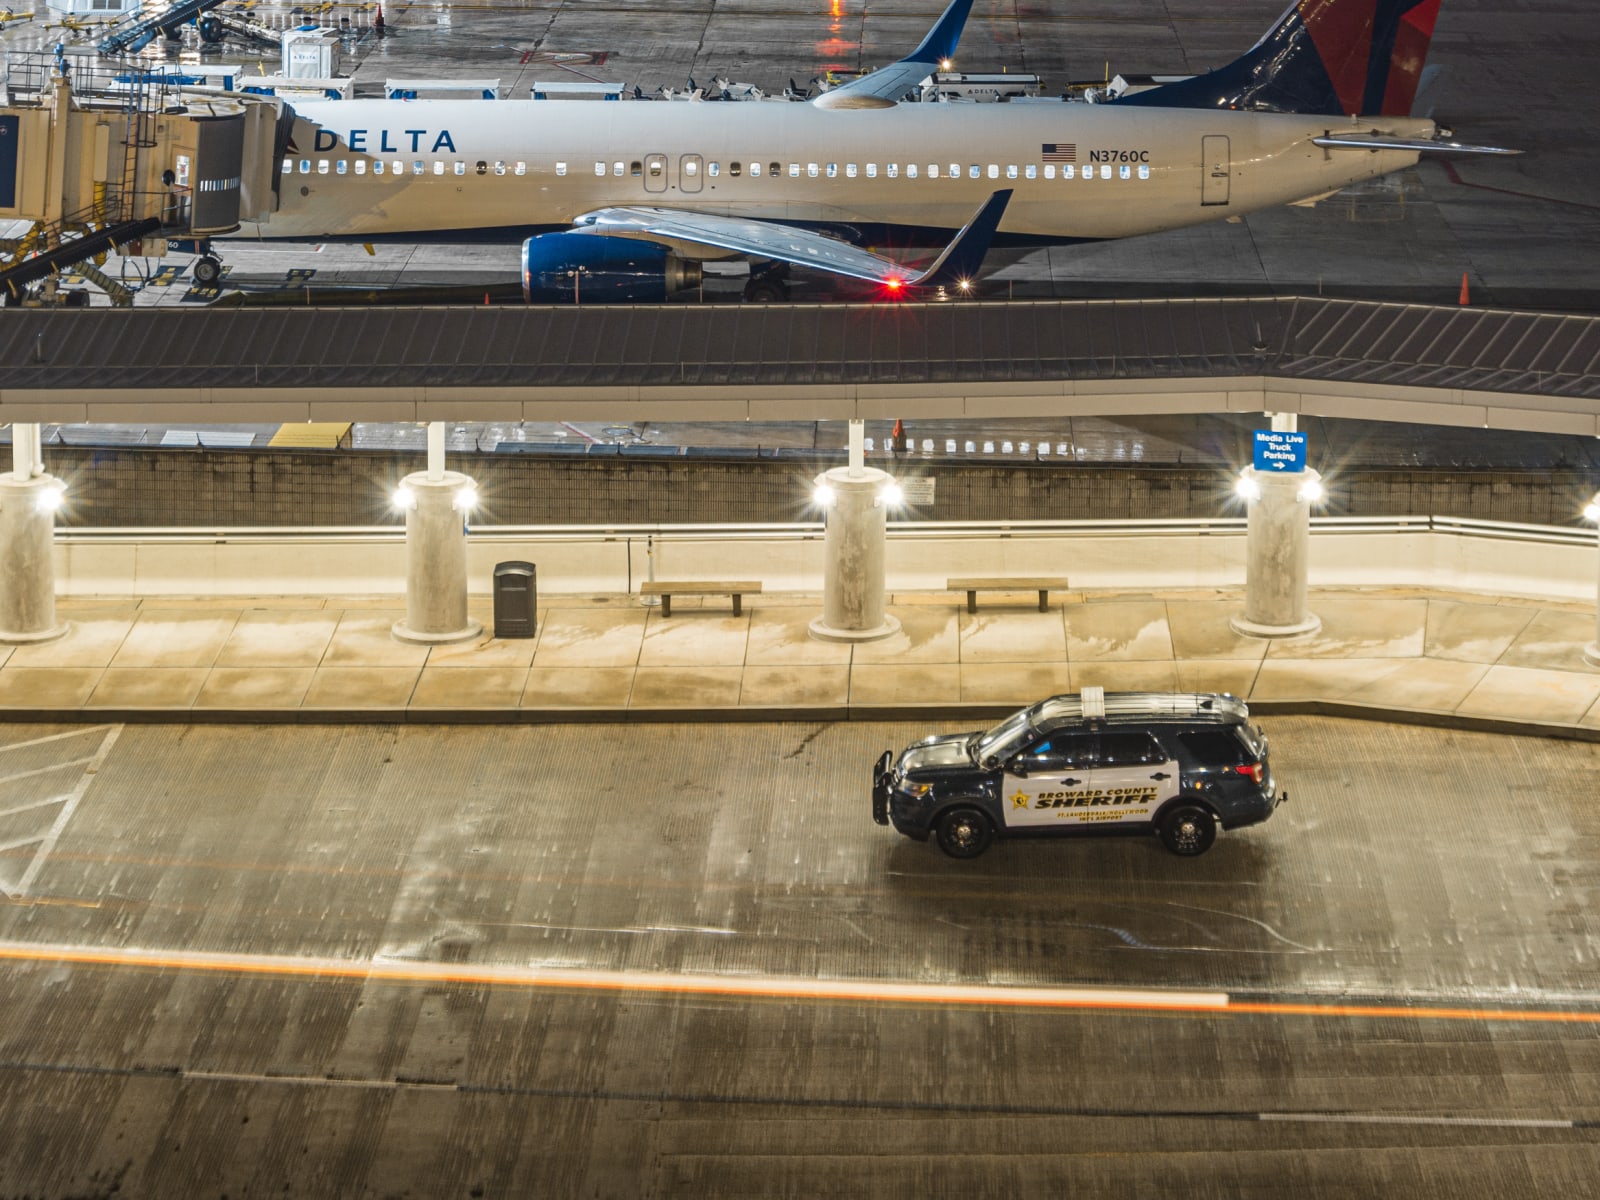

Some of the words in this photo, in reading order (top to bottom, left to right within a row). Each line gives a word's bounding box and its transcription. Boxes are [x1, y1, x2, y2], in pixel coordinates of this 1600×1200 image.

[314, 129, 457, 153] DELTA
[1090, 150, 1150, 163] N3760C
[168, 241, 179, 249] 60
[1256, 433, 1283, 443] Media
[1286, 435, 1304, 443] Live
[1268, 442, 1292, 451] Truck
[1263, 451, 1296, 462] Parking
[1038, 789, 1102, 799] BROWARD
[1106, 786, 1158, 795] COUNTY
[1034, 793, 1158, 809] SHERIFF
